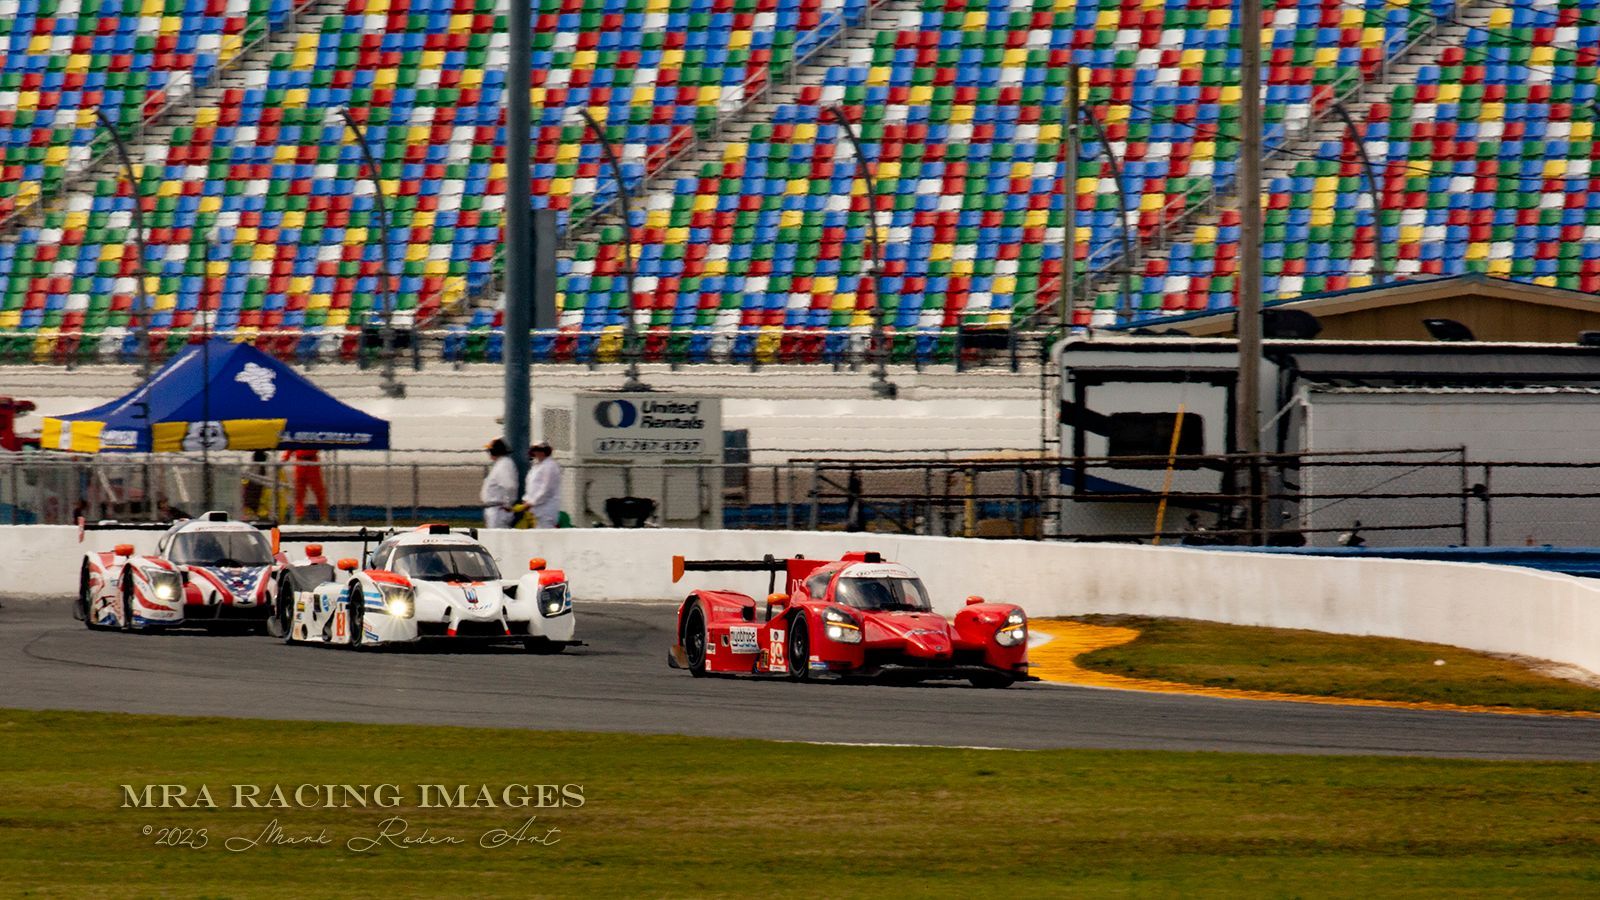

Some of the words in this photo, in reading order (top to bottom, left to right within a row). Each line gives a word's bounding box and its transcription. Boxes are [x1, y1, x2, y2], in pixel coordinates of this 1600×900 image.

[642, 401, 700, 413] United
[640, 416, 705, 429] Rentals
[770, 642, 785, 665] 99
